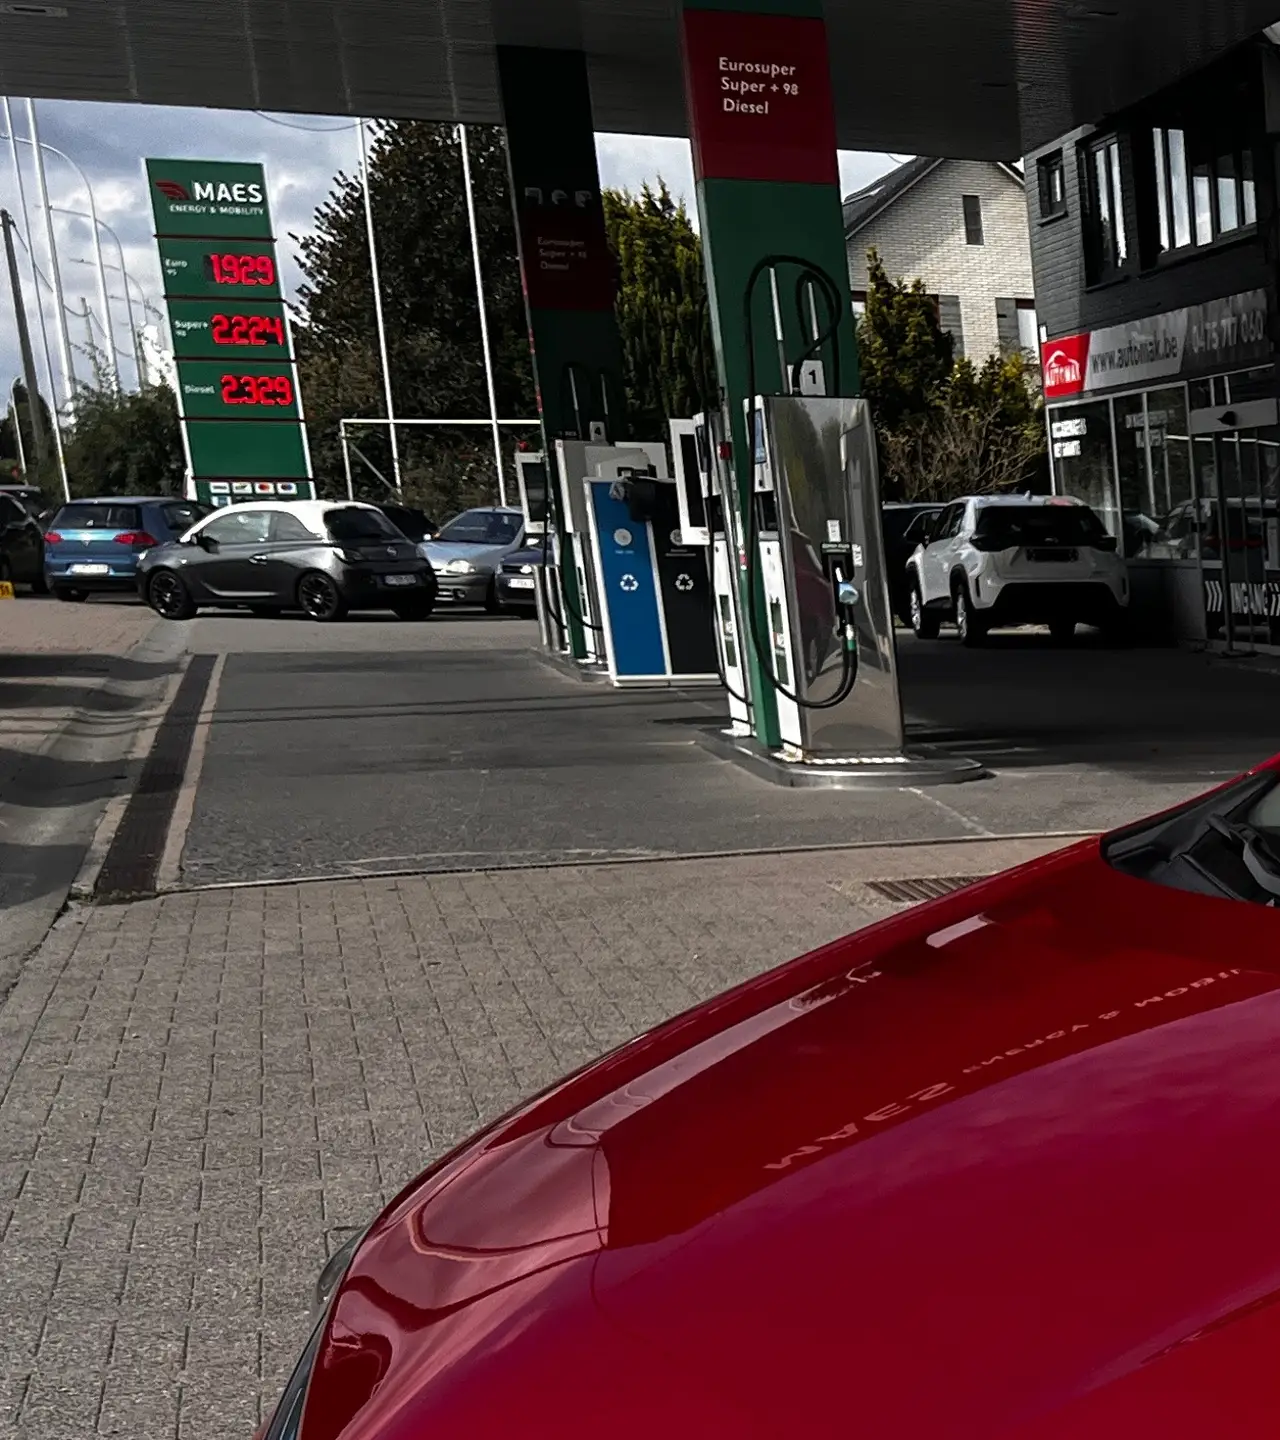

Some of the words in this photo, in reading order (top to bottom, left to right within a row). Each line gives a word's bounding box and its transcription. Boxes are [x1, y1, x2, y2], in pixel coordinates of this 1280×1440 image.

[719, 57, 796, 78] Eurosuper
[720, 77, 766, 95] Super
[782, 83, 799, 95] 98
[723, 98, 769, 114] Diesel
[193, 181, 263, 203] MAES
[169, 203, 206, 214] ENERGY
[219, 205, 264, 216] MOBILITY
[164, 258, 188, 268] Euro
[808, 369, 817, 384] 1
